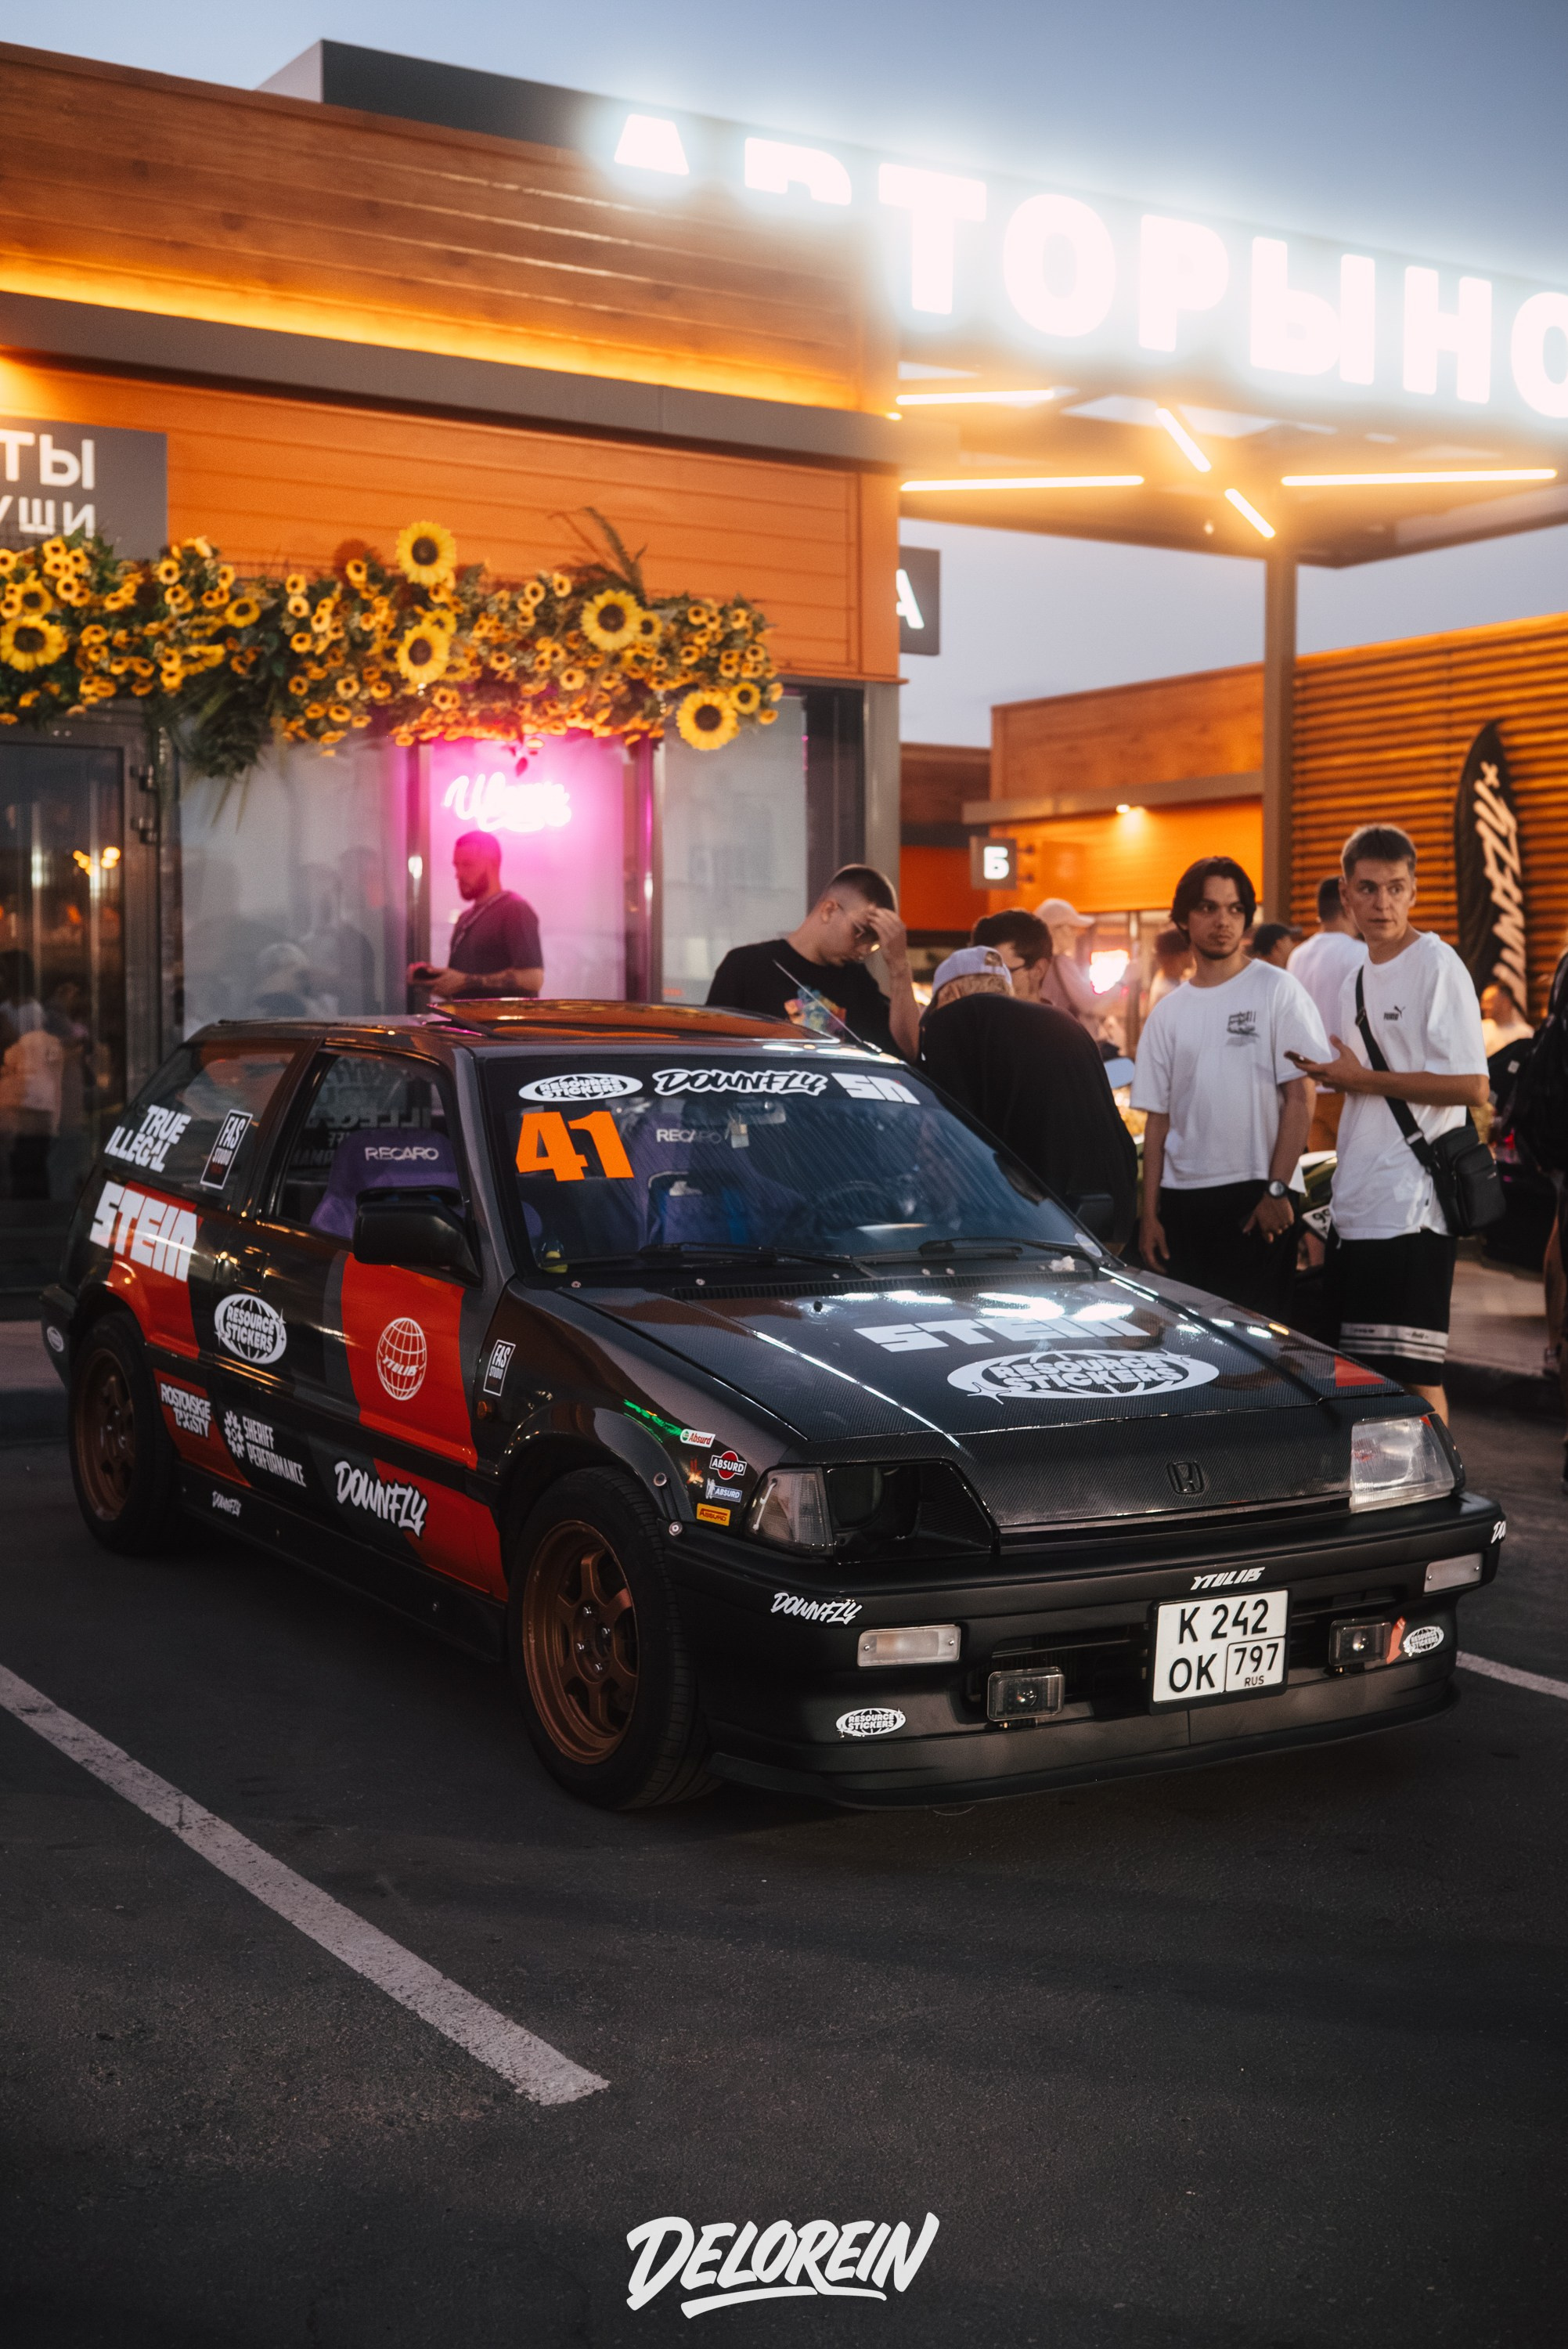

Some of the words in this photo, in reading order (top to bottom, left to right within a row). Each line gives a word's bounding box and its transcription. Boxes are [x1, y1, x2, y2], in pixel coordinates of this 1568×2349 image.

[983, 846, 1010, 880] Б
[540, 1077, 618, 1093] RESOURCE
[542, 1084, 624, 1098] STICKERS
[653, 1069, 828, 1095] DOWNFLY
[139, 1104, 192, 1145] TRUE
[218, 1116, 247, 1149] FAS
[104, 1126, 171, 1173] ILLEGAL
[364, 1146, 439, 1161] RECARO
[515, 1110, 634, 1182] 41
[89, 1180, 198, 1283] STEIN
[226, 1306, 276, 1333] RESOURCE
[225, 1322, 273, 1353] STICKERS
[492, 1344, 511, 1369] FAS
[988, 1356, 1170, 1379] RESOURCE
[1002, 1368, 1184, 1391] STICKERS
[242, 1415, 275, 1450] SHERIFF
[688, 1432, 713, 1445] Absurd
[246, 1442, 308, 1488] PERFORMANCE
[711, 1458, 744, 1474] ABSURD
[333, 1460, 428, 1538] DOWNFLY
[715, 1487, 741, 1499] ABSURD
[699, 1508, 728, 1521] ABSURD
[770, 1592, 863, 1625] DOWNFLY
[1211, 1598, 1269, 1640] 242
[1234, 1642, 1279, 1675] 797
[1244, 1676, 1265, 1687] RUS
[847, 1720, 894, 1730] STICKERS
[848, 1713, 895, 1723] RESOURCE
